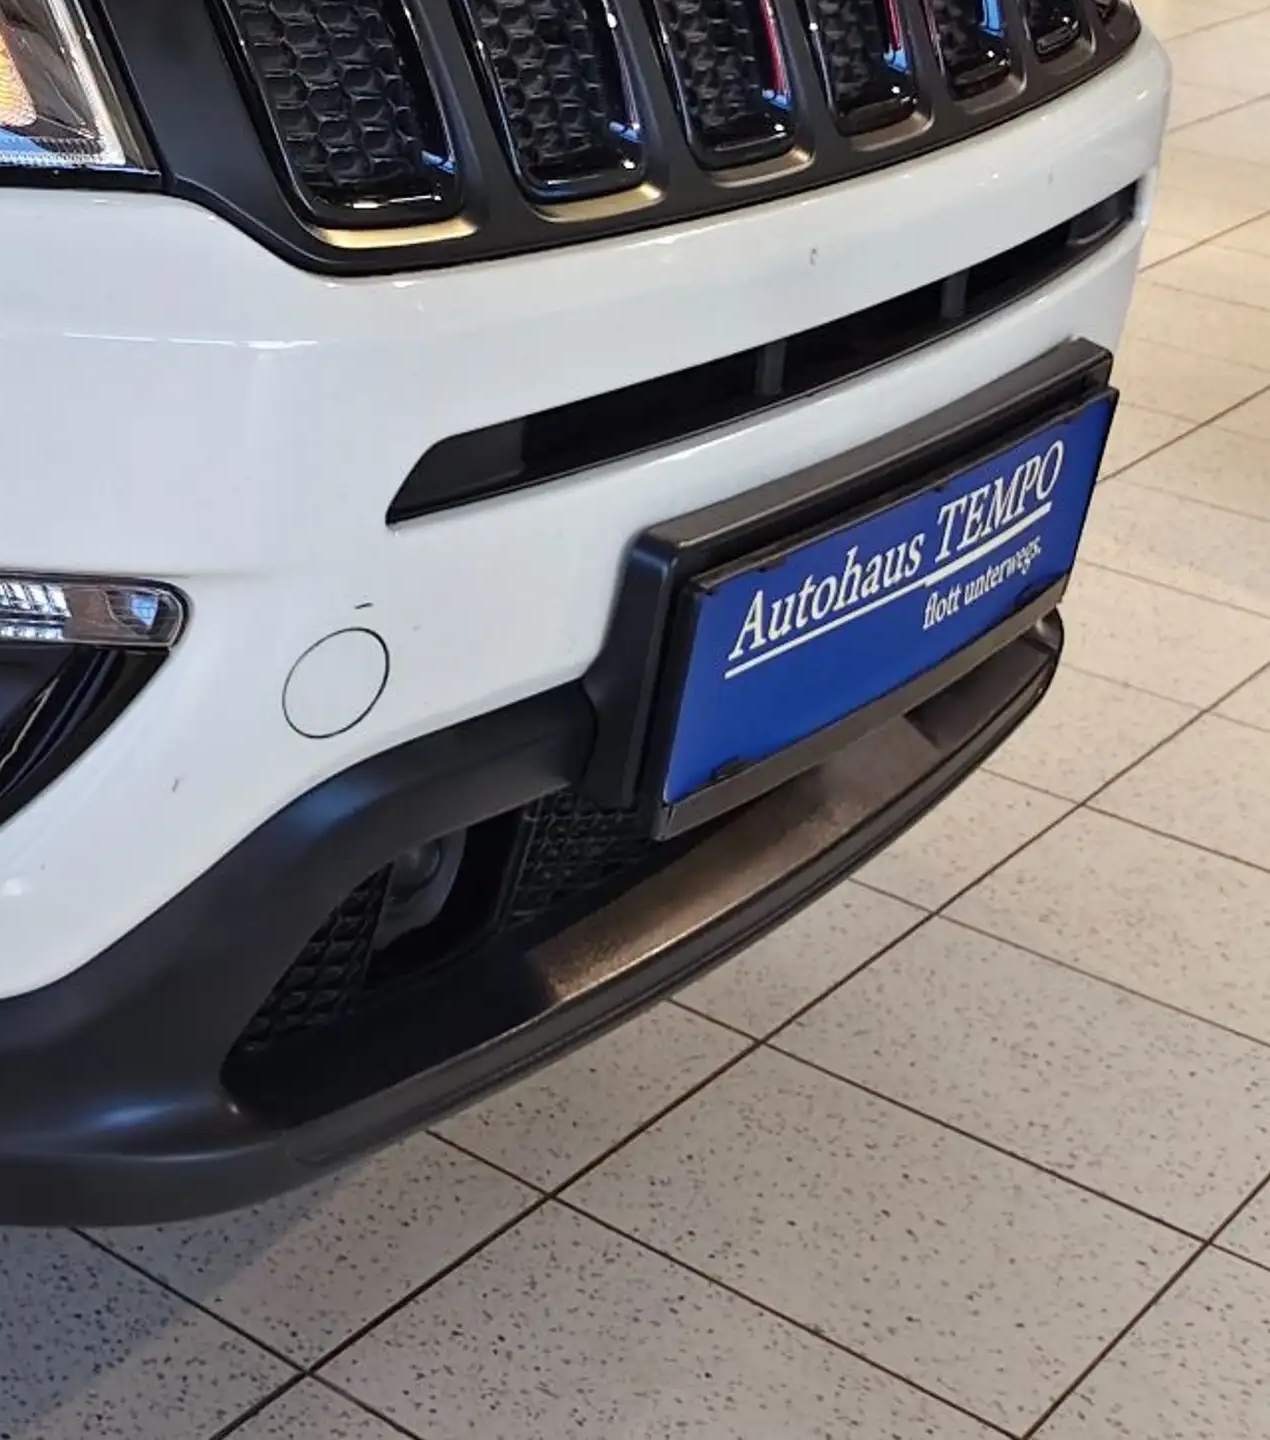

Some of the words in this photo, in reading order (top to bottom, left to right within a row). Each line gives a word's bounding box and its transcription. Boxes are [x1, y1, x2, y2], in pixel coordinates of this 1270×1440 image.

[728, 533, 926, 662] Autohaus
[935, 440, 1065, 563] TEMPO
[923, 583, 962, 631] flott
